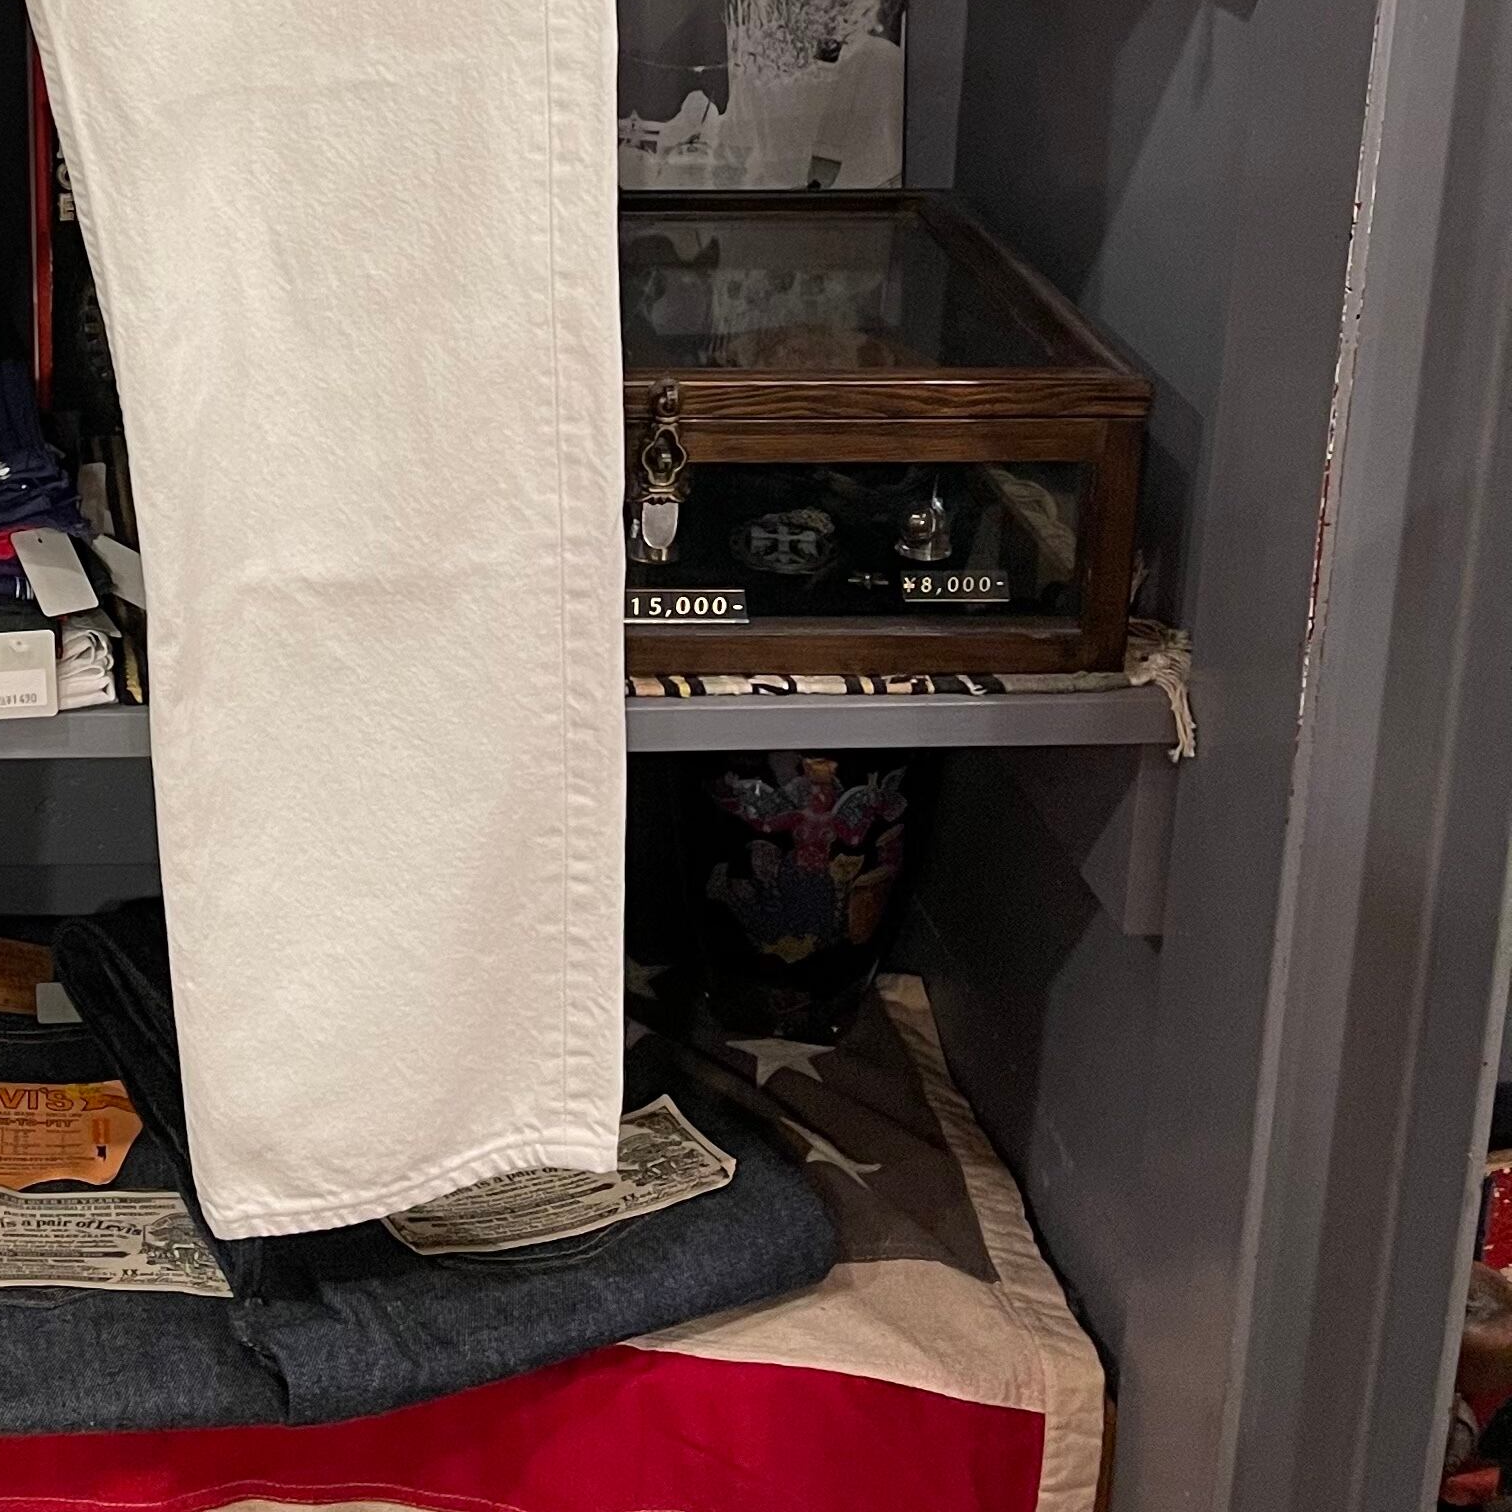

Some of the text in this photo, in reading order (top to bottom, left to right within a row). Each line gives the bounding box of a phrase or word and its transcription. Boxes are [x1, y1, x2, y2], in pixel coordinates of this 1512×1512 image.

[0, 1217, 18, 1229] is
[20, 1218, 32, 1228] a
[35, 1217, 72, 1229] pair
[75, 1220, 97, 1230] of
